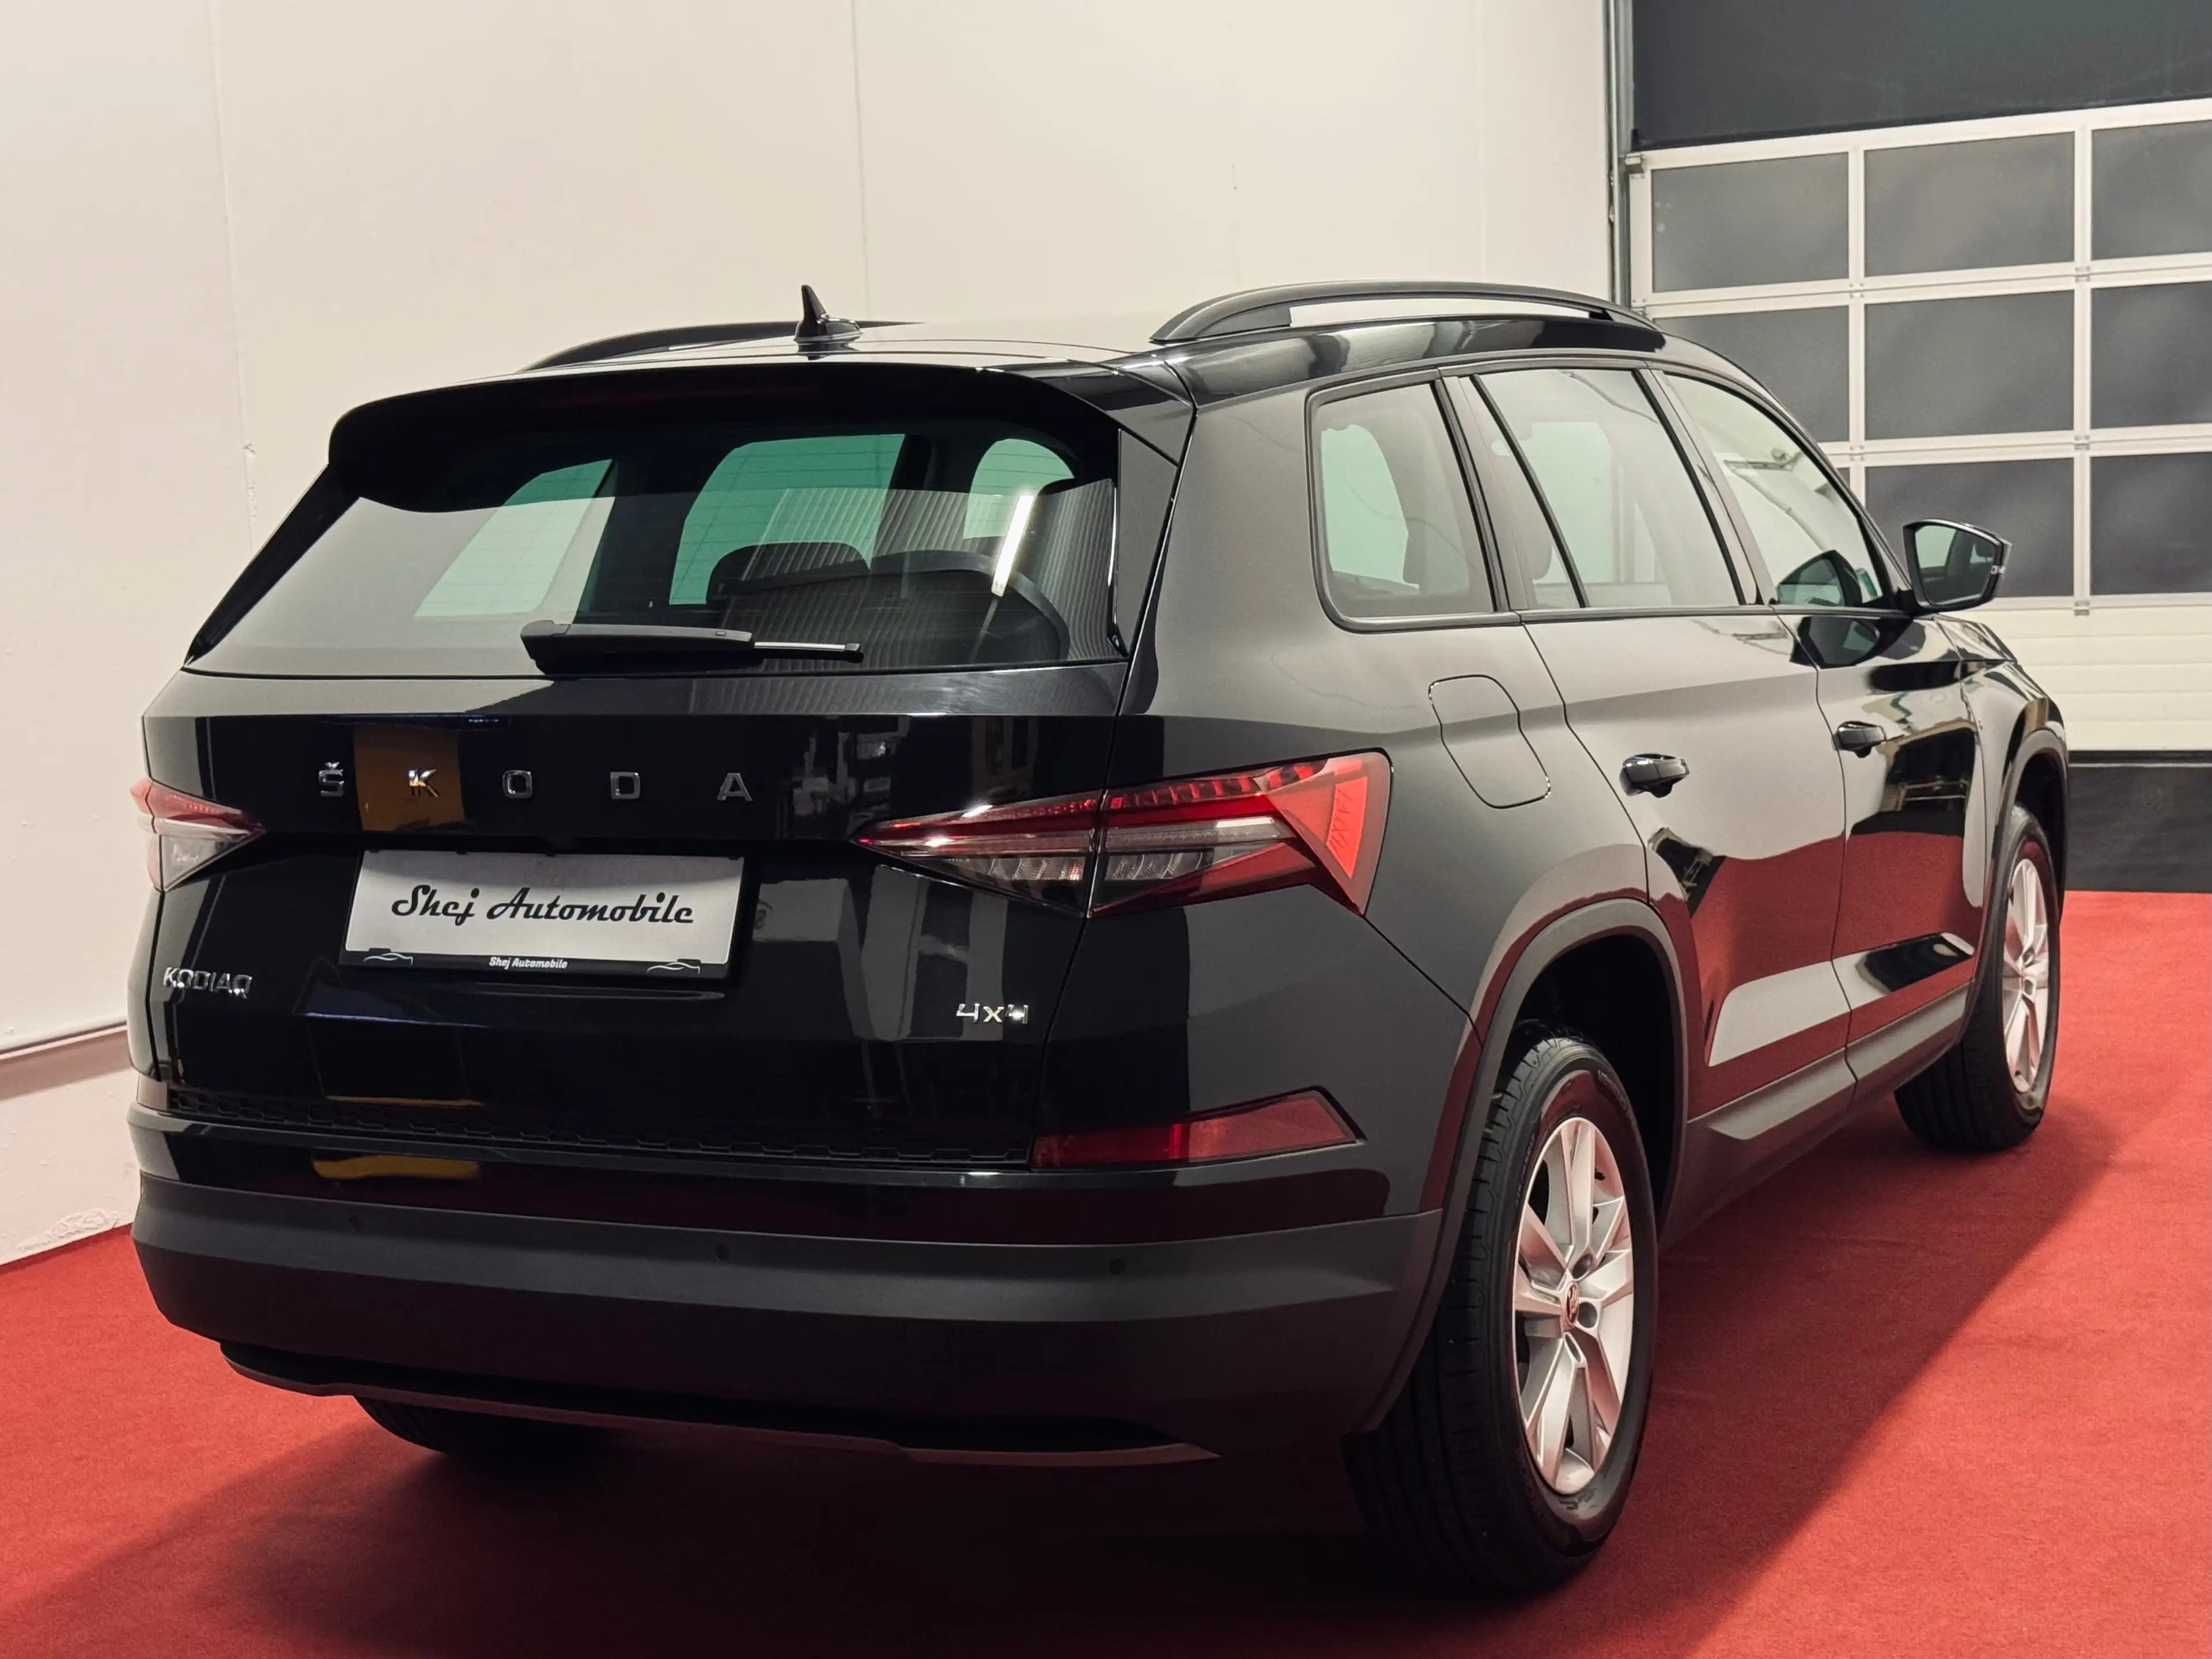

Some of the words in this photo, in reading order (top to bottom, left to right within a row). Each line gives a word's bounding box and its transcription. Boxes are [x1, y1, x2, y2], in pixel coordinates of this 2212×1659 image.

[318, 762, 753, 801] ŠKODA
[391, 884, 480, 926] Shej
[486, 887, 694, 923] Automobile
[489, 956, 512, 970] Shej
[512, 957, 568, 969] Automobile
[163, 967, 252, 999] KODIAQ
